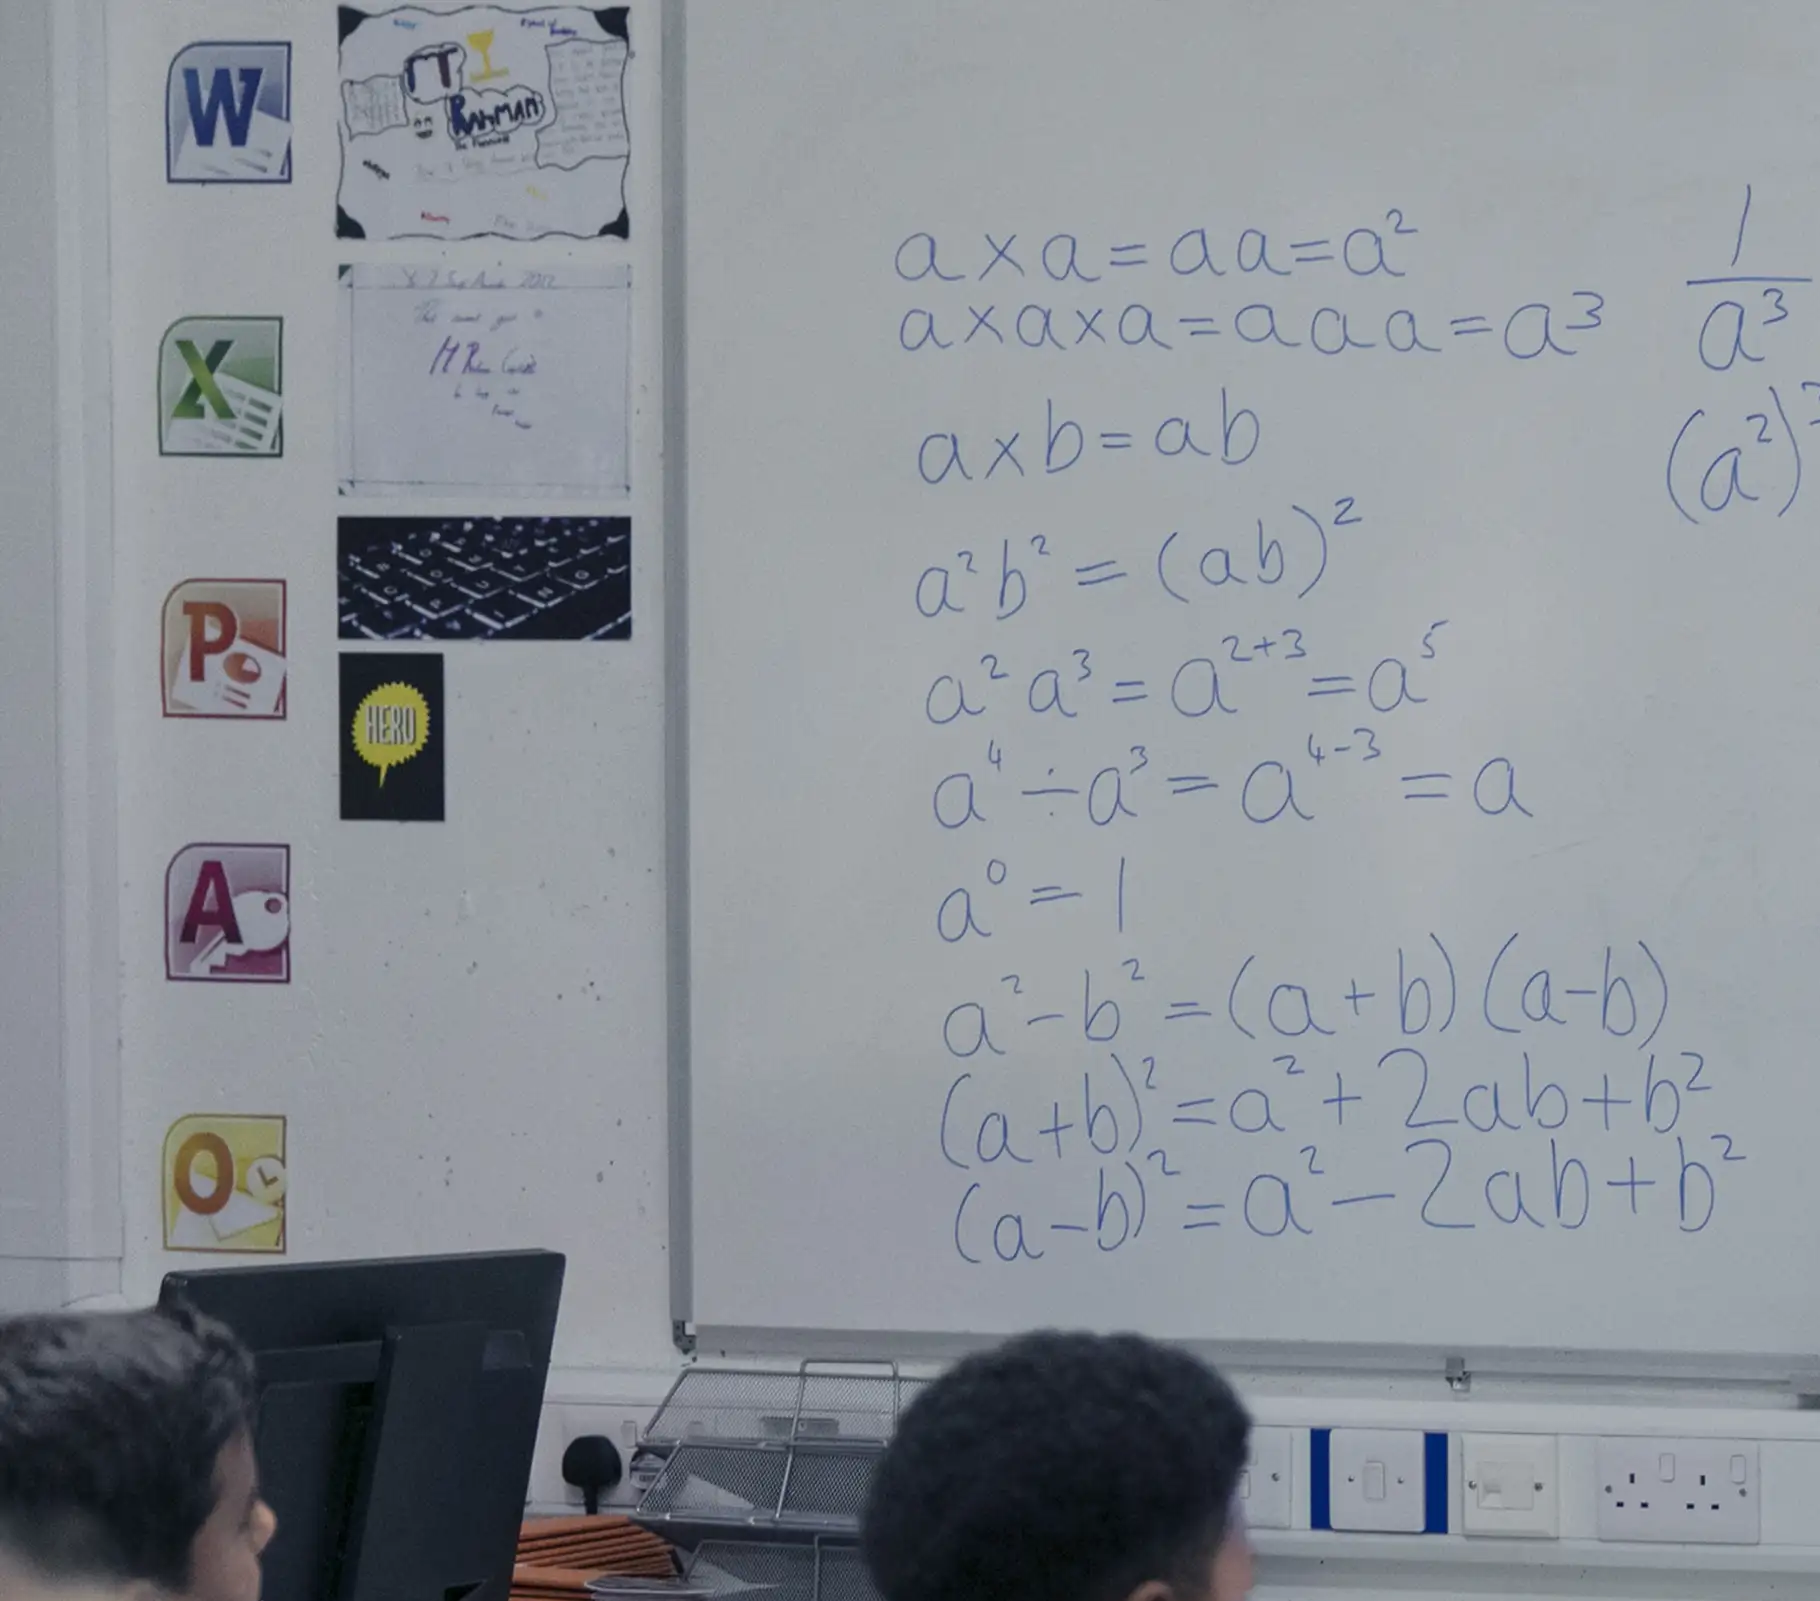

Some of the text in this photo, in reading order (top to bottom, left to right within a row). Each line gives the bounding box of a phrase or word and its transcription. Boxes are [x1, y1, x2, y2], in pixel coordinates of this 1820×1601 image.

[182, 67, 264, 148] W
[171, 339, 235, 420] X
[182, 601, 238, 683] P
[365, 705, 417, 746] HERO
[181, 859, 243, 944] A
[174, 1131, 235, 1215] O
